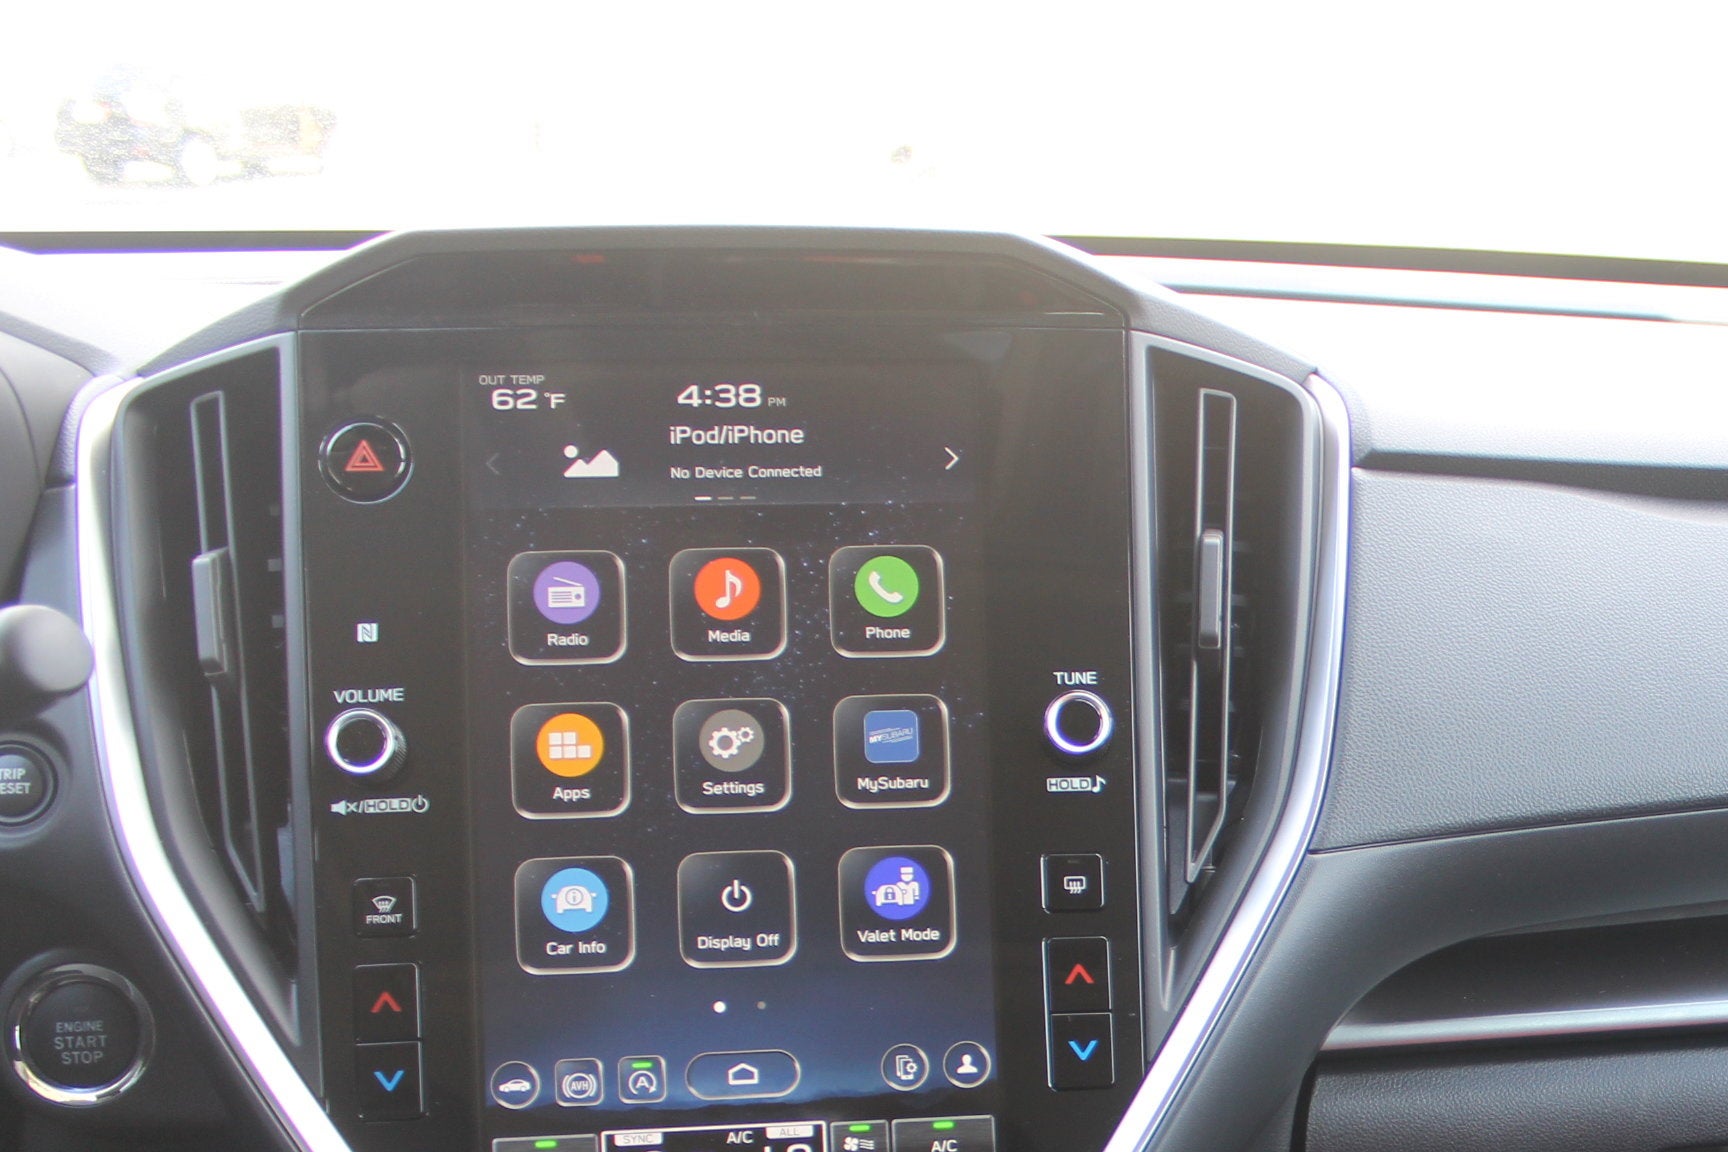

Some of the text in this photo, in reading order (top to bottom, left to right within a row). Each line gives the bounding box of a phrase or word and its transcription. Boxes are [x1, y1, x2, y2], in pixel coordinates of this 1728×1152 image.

[478, 374, 546, 385] OUT TEMP
[490, 388, 538, 411] 62
[676, 383, 787, 409] 4:38 PM
[669, 425, 805, 446] iPod/iPhone
[670, 464, 823, 480] No Device Connected
[547, 632, 589, 647] Radio
[707, 628, 751, 643] Media
[864, 625, 911, 640] Phone
[1053, 671, 1098, 685] TUNE
[333, 687, 405, 704] VOLUME
[0, 782, 31, 794] ESET
[702, 780, 765, 797] Settings
[857, 775, 930, 793] MySubaru
[1047, 778, 1091, 792] HOLD
[552, 786, 591, 802] Apps
[366, 913, 402, 924] FRONT
[697, 933, 780, 951] Display Off
[857, 927, 940, 943] Valet Mode
[546, 940, 607, 956] Car Info
[55, 1020, 104, 1033] ENGINE
[54, 1035, 107, 1050] START
[61, 1051, 104, 1065] STOP
[570, 1080, 589, 1092] AVH
[623, 1133, 654, 1145] SYNC
[726, 1130, 755, 1145] A/C
[779, 1127, 800, 1137] ALL
